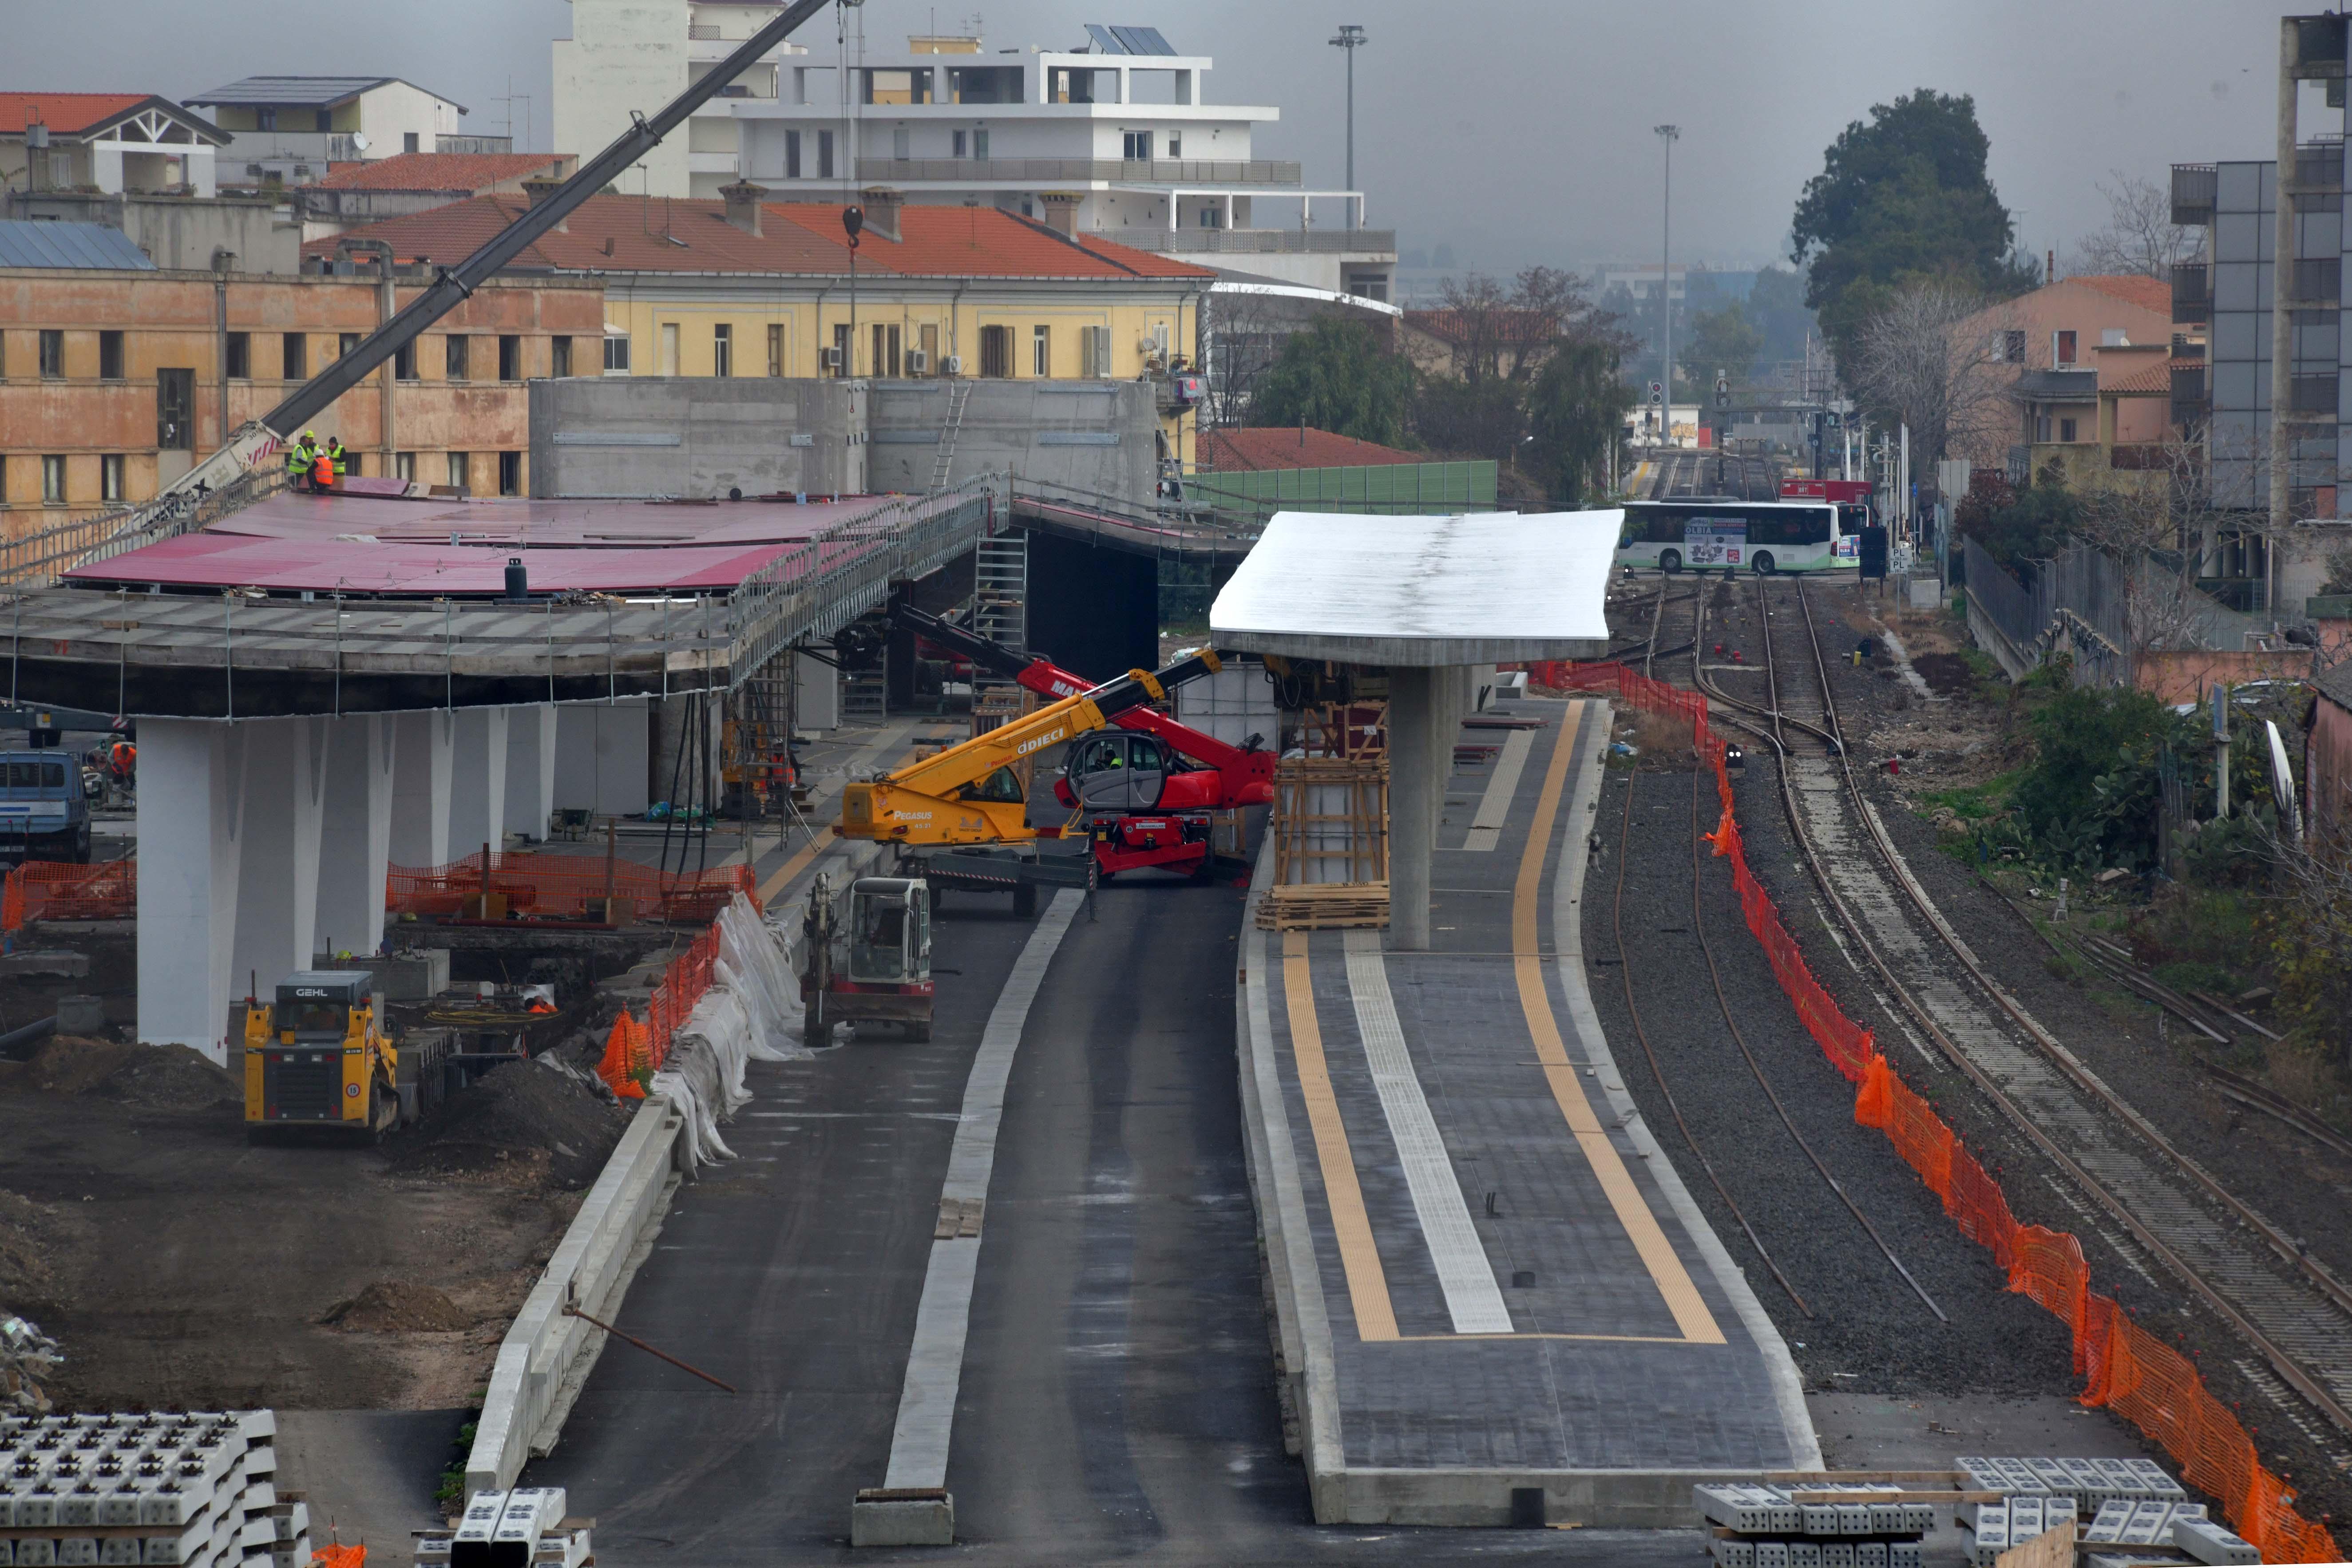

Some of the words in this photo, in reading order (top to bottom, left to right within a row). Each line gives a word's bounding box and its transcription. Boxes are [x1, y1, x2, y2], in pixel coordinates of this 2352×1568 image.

[990, 755, 1013, 768] PEGASUS
[894, 810, 932, 820] PEGASUS
[296, 988, 328, 997] GEHL
